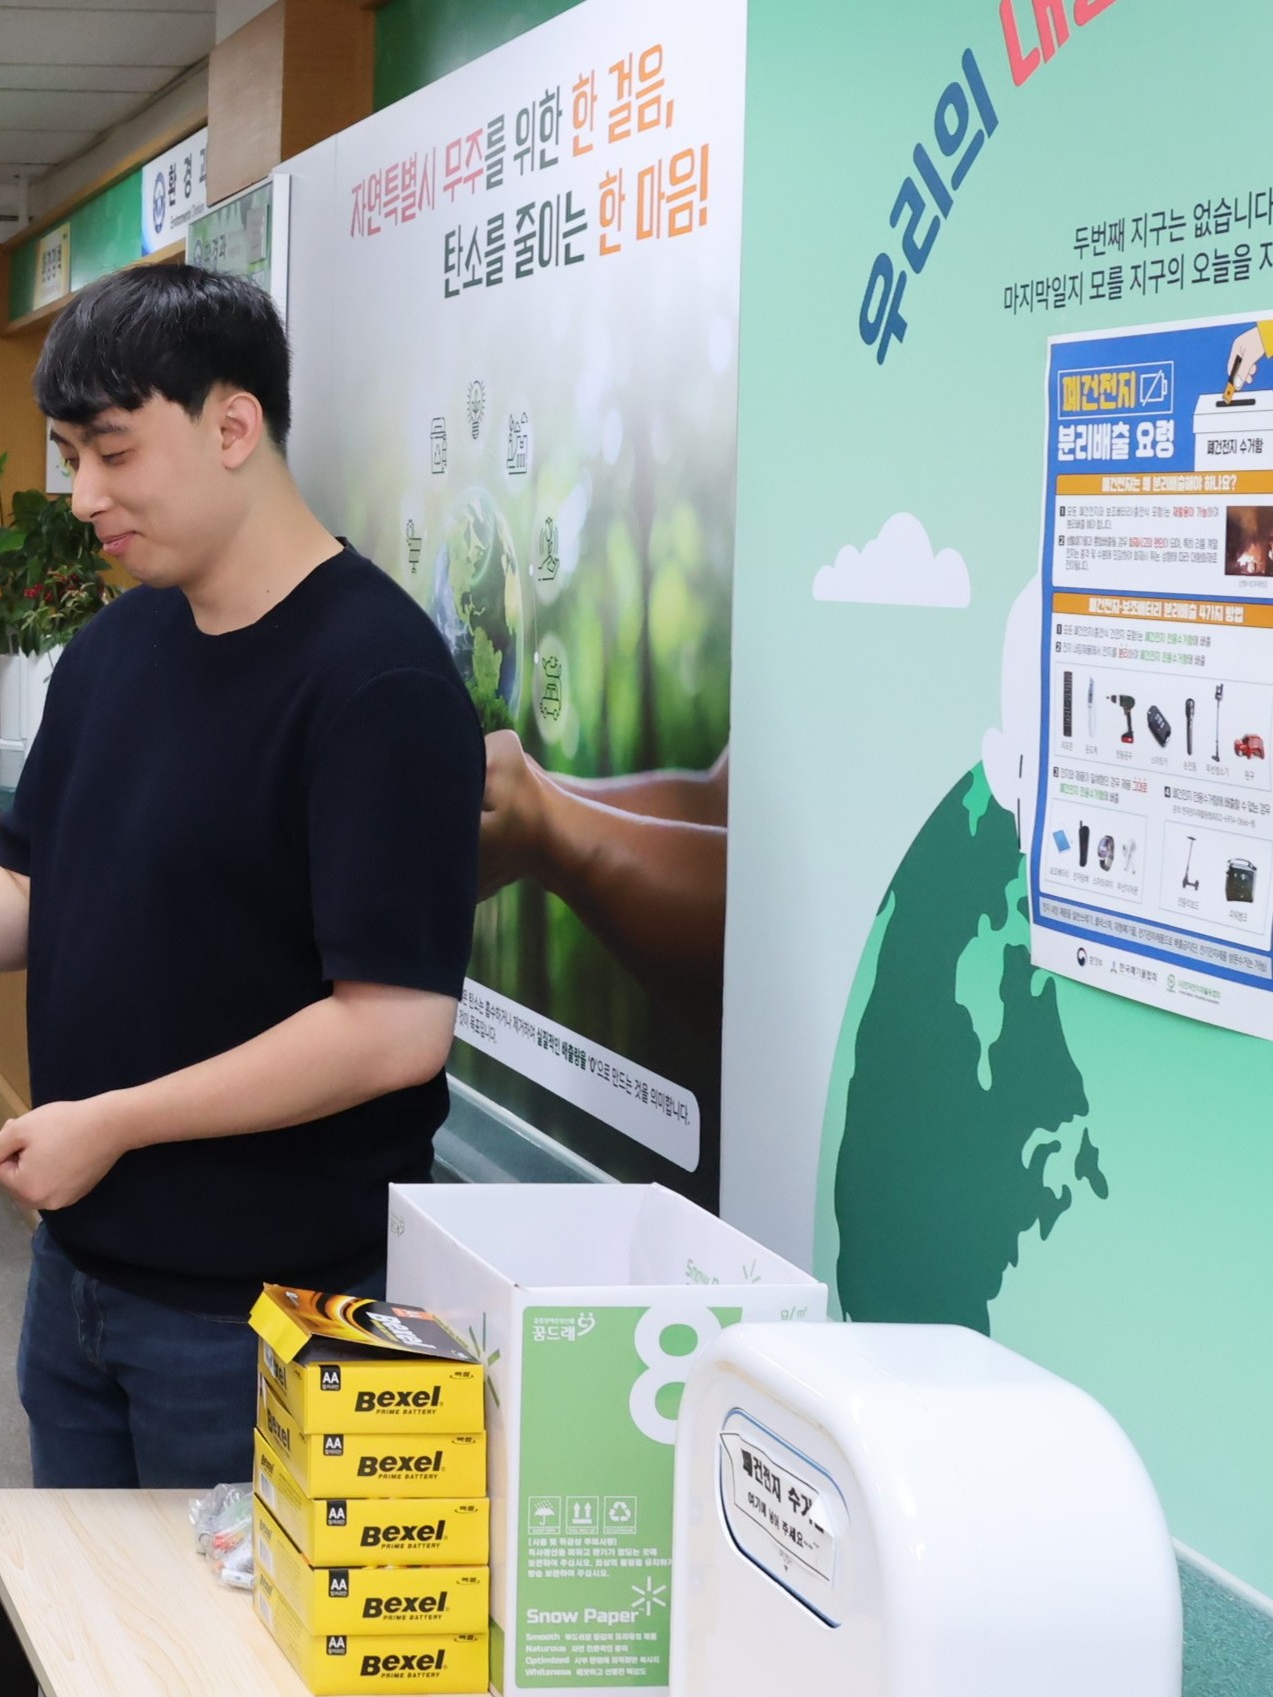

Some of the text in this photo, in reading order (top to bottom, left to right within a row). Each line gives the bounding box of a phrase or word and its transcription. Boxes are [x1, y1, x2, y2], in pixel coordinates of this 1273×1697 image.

[350, 44, 675, 239] 자연특별시 무주를 위한 한 걸음,
[859, 48, 999, 365] 우리의
[444, 144, 710, 299] 탄소를 줄이는 한 마음!
[1073, 217, 1125, 260] 두번째
[1130, 208, 1187, 249] 지구는
[1004, 271, 1084, 315] 마지막일지
[1089, 265, 1125, 301] 모를
[1129, 253, 1186, 297] 지구의
[1191, 244, 1253, 285] 오늘을
[1062, 370, 1136, 412] 폐건전지
[1058, 419, 1175, 461] 분리배출 요령
[611, 1066, 633, 1095] 만드는
[634, 1078, 649, 1104] 것을
[650, 1087, 691, 1125] 의미합니다.
[532, 1325, 575, 1341] 꿈드래
[323, 1372, 339, 1384] AA
[355, 1386, 441, 1412] Bexel
[325, 1437, 342, 1449] AA
[357, 1450, 443, 1477] Bexel
[328, 1507, 345, 1519] AA
[360, 1520, 446, 1547] Bexel
[330, 1578, 347, 1590] AA
[362, 1591, 448, 1618] Bexel
[526, 1608, 639, 1626] Snow Paper
[328, 1636, 345, 1648] AA
[525, 1632, 560, 1641] Smooth
[360, 1649, 445, 1676] Bexel
